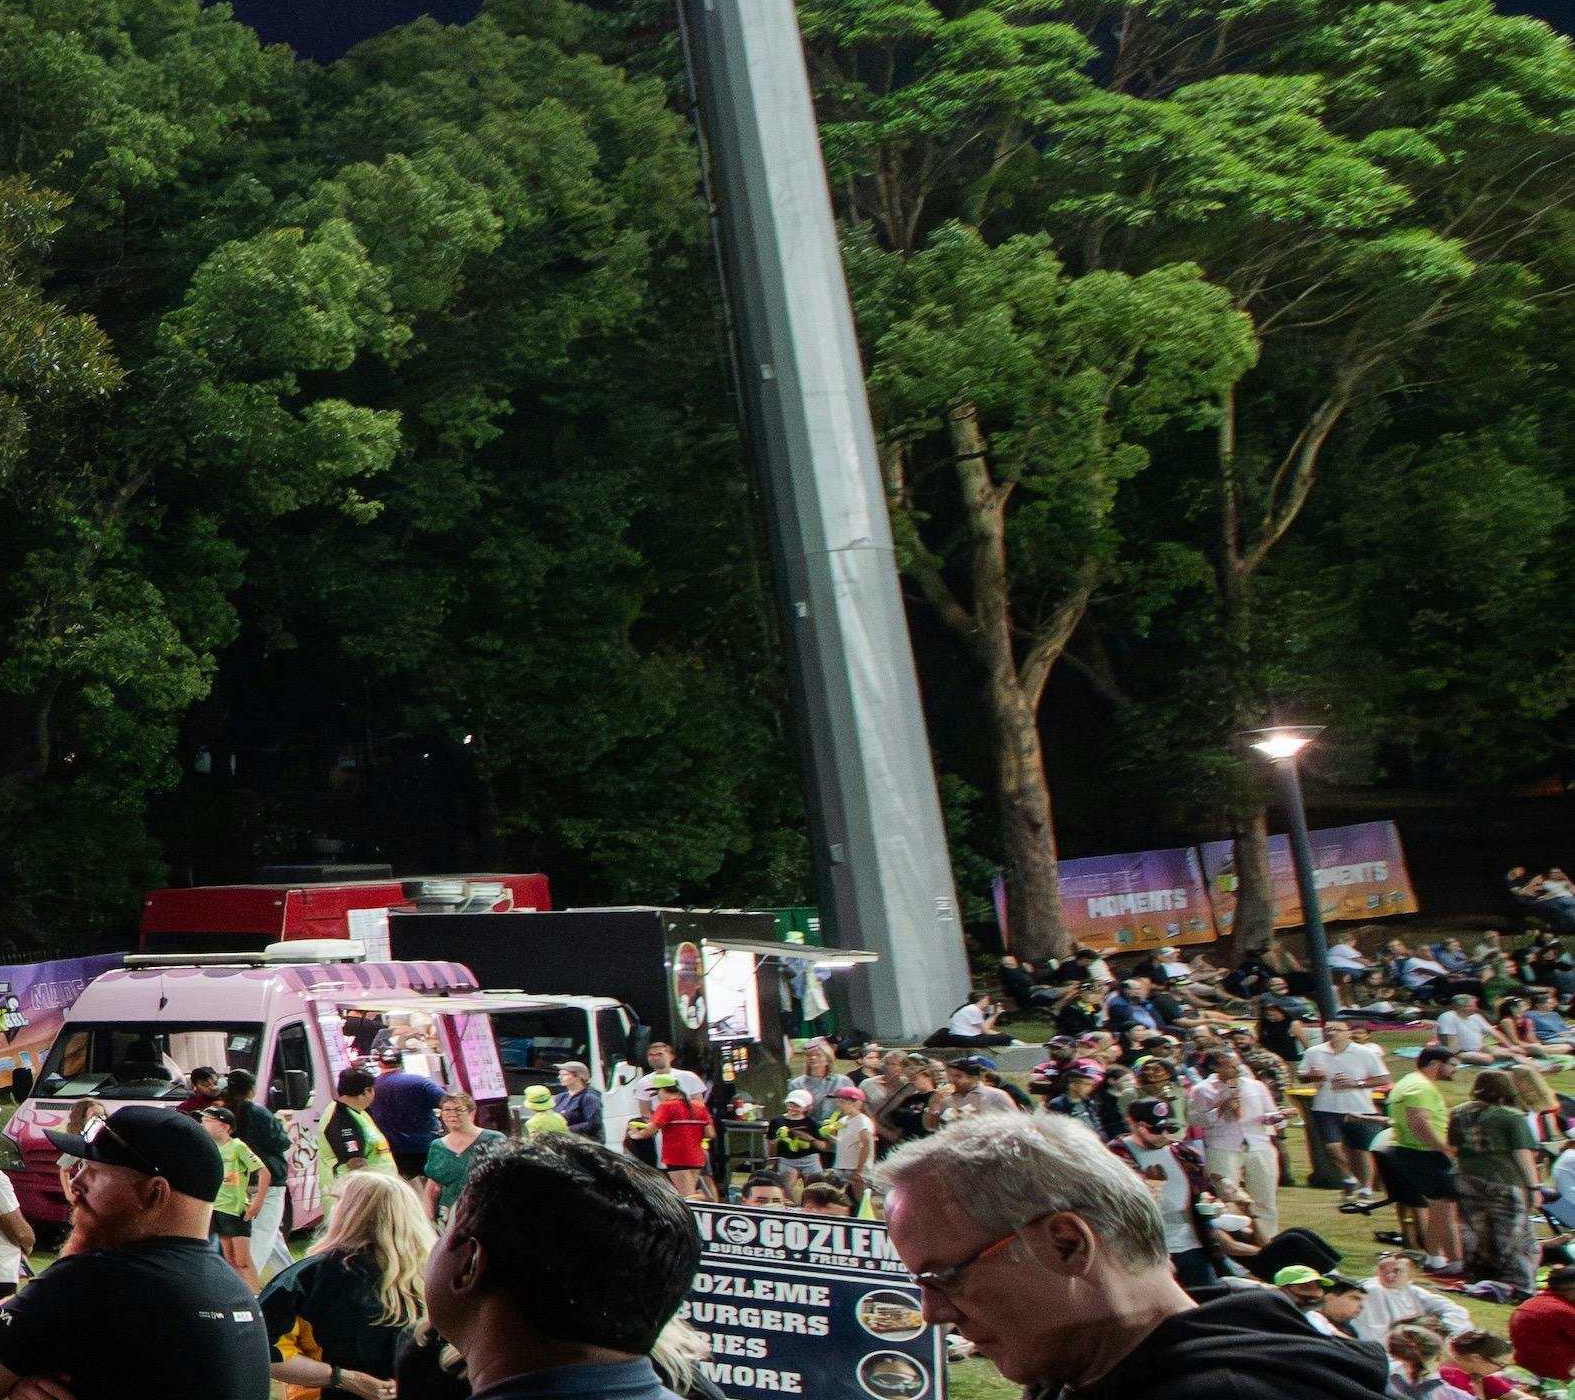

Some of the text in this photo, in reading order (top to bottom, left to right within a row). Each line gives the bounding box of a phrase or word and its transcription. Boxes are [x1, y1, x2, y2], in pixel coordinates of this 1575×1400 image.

[1087, 887, 1188, 919] MOMENTS
[710, 1243, 787, 1260] BURGERS
[809, 1251, 860, 1269] FRIES
